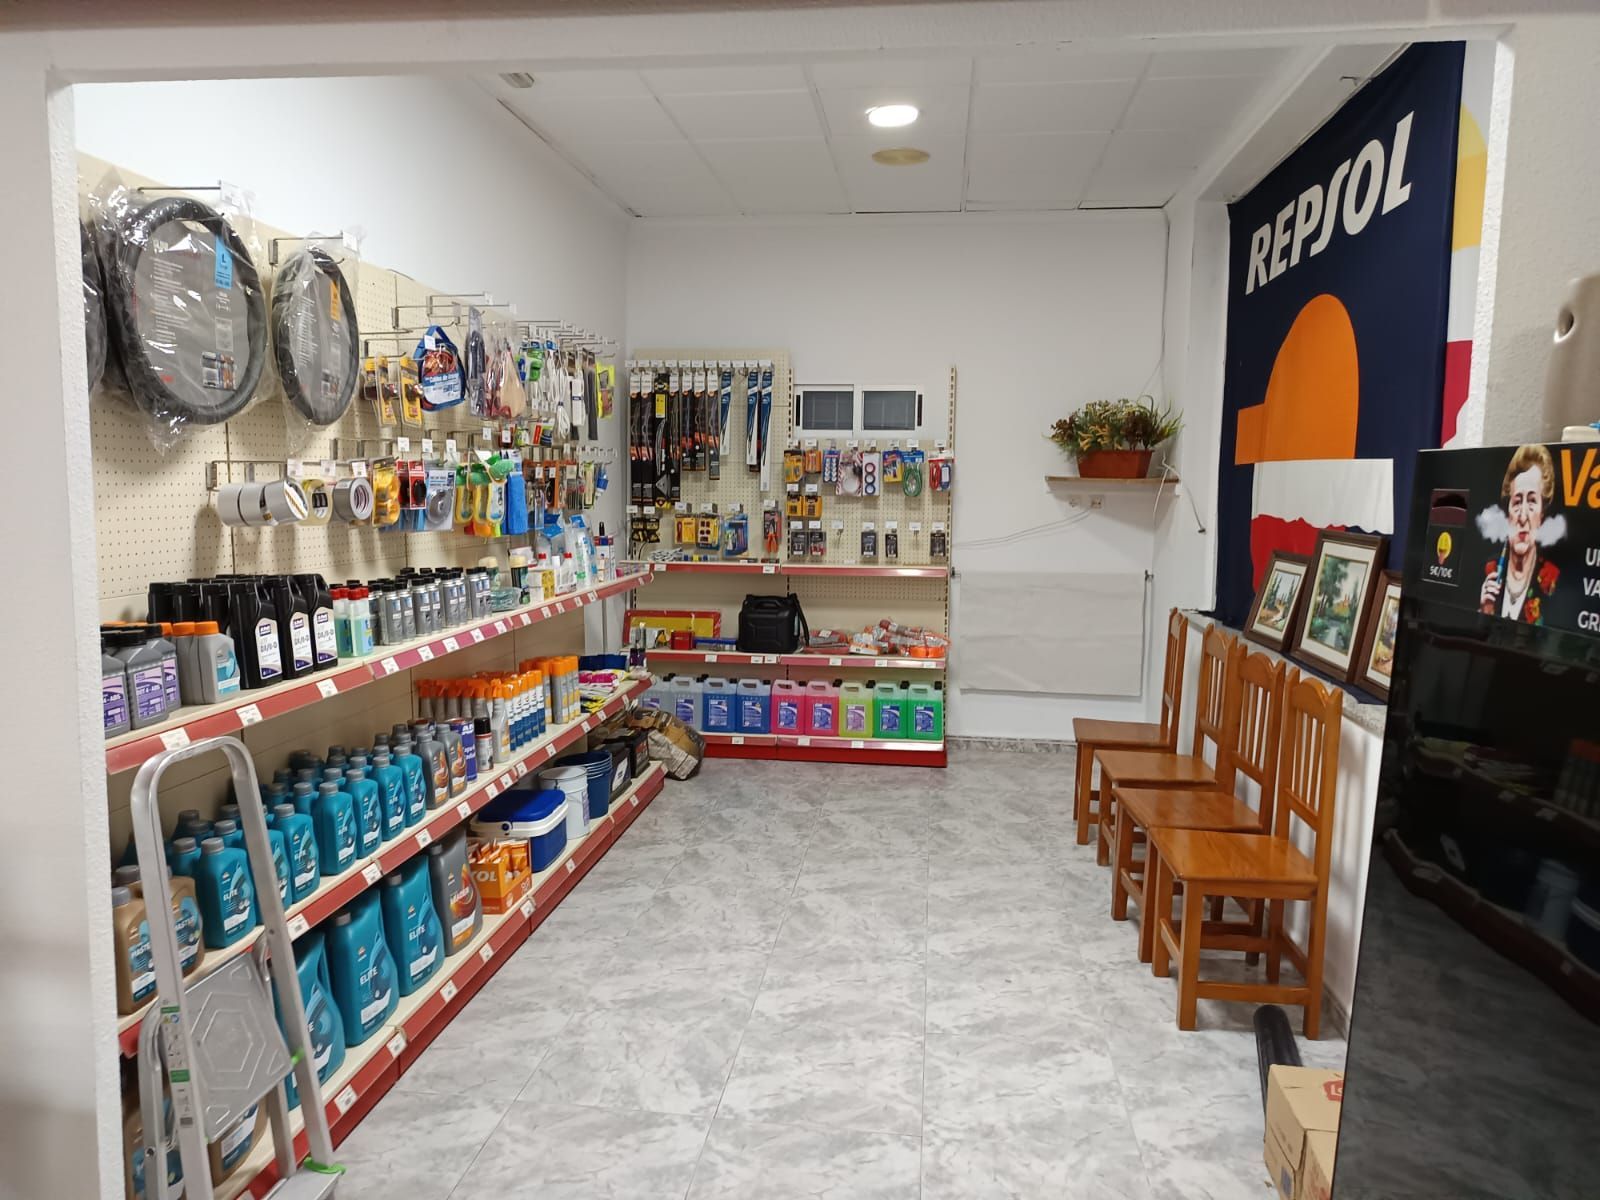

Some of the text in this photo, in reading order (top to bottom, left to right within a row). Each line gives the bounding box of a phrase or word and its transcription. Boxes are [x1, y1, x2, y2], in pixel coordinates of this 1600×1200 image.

[1245, 110, 1415, 296] REPSOL
[409, 924, 426, 941] ELITE
[360, 966, 379, 986] ELITE
